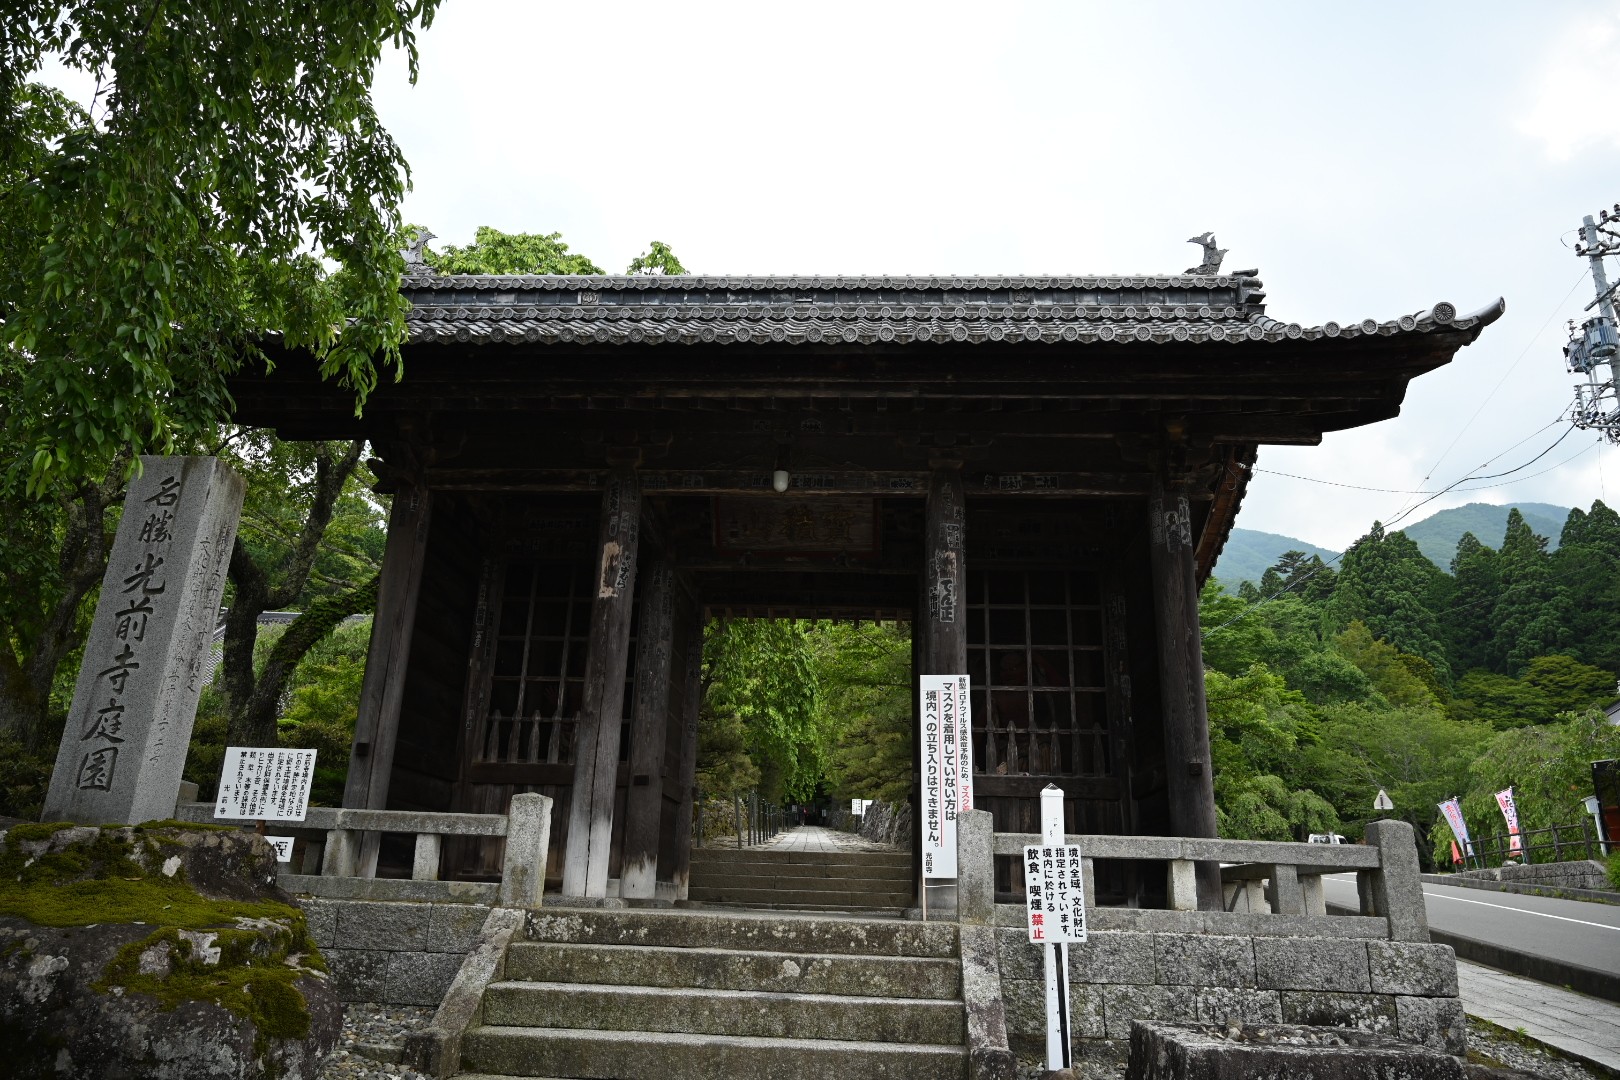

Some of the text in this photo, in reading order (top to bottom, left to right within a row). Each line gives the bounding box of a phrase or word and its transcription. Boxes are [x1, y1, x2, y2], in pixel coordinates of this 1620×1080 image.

[75, 476, 180, 793] 名勝光前寺庭園
[925, 690, 940, 847] 境内への立ち入りはできません。
[942, 682, 957, 821] マスクを着用していない方は
[925, 852, 933, 873] 光前寺
[1042, 848, 1055, 912] 境内に於ける
[1055, 848, 1071, 937] 指定されています。
[1068, 848, 1084, 938] 境内全域、文化財に
